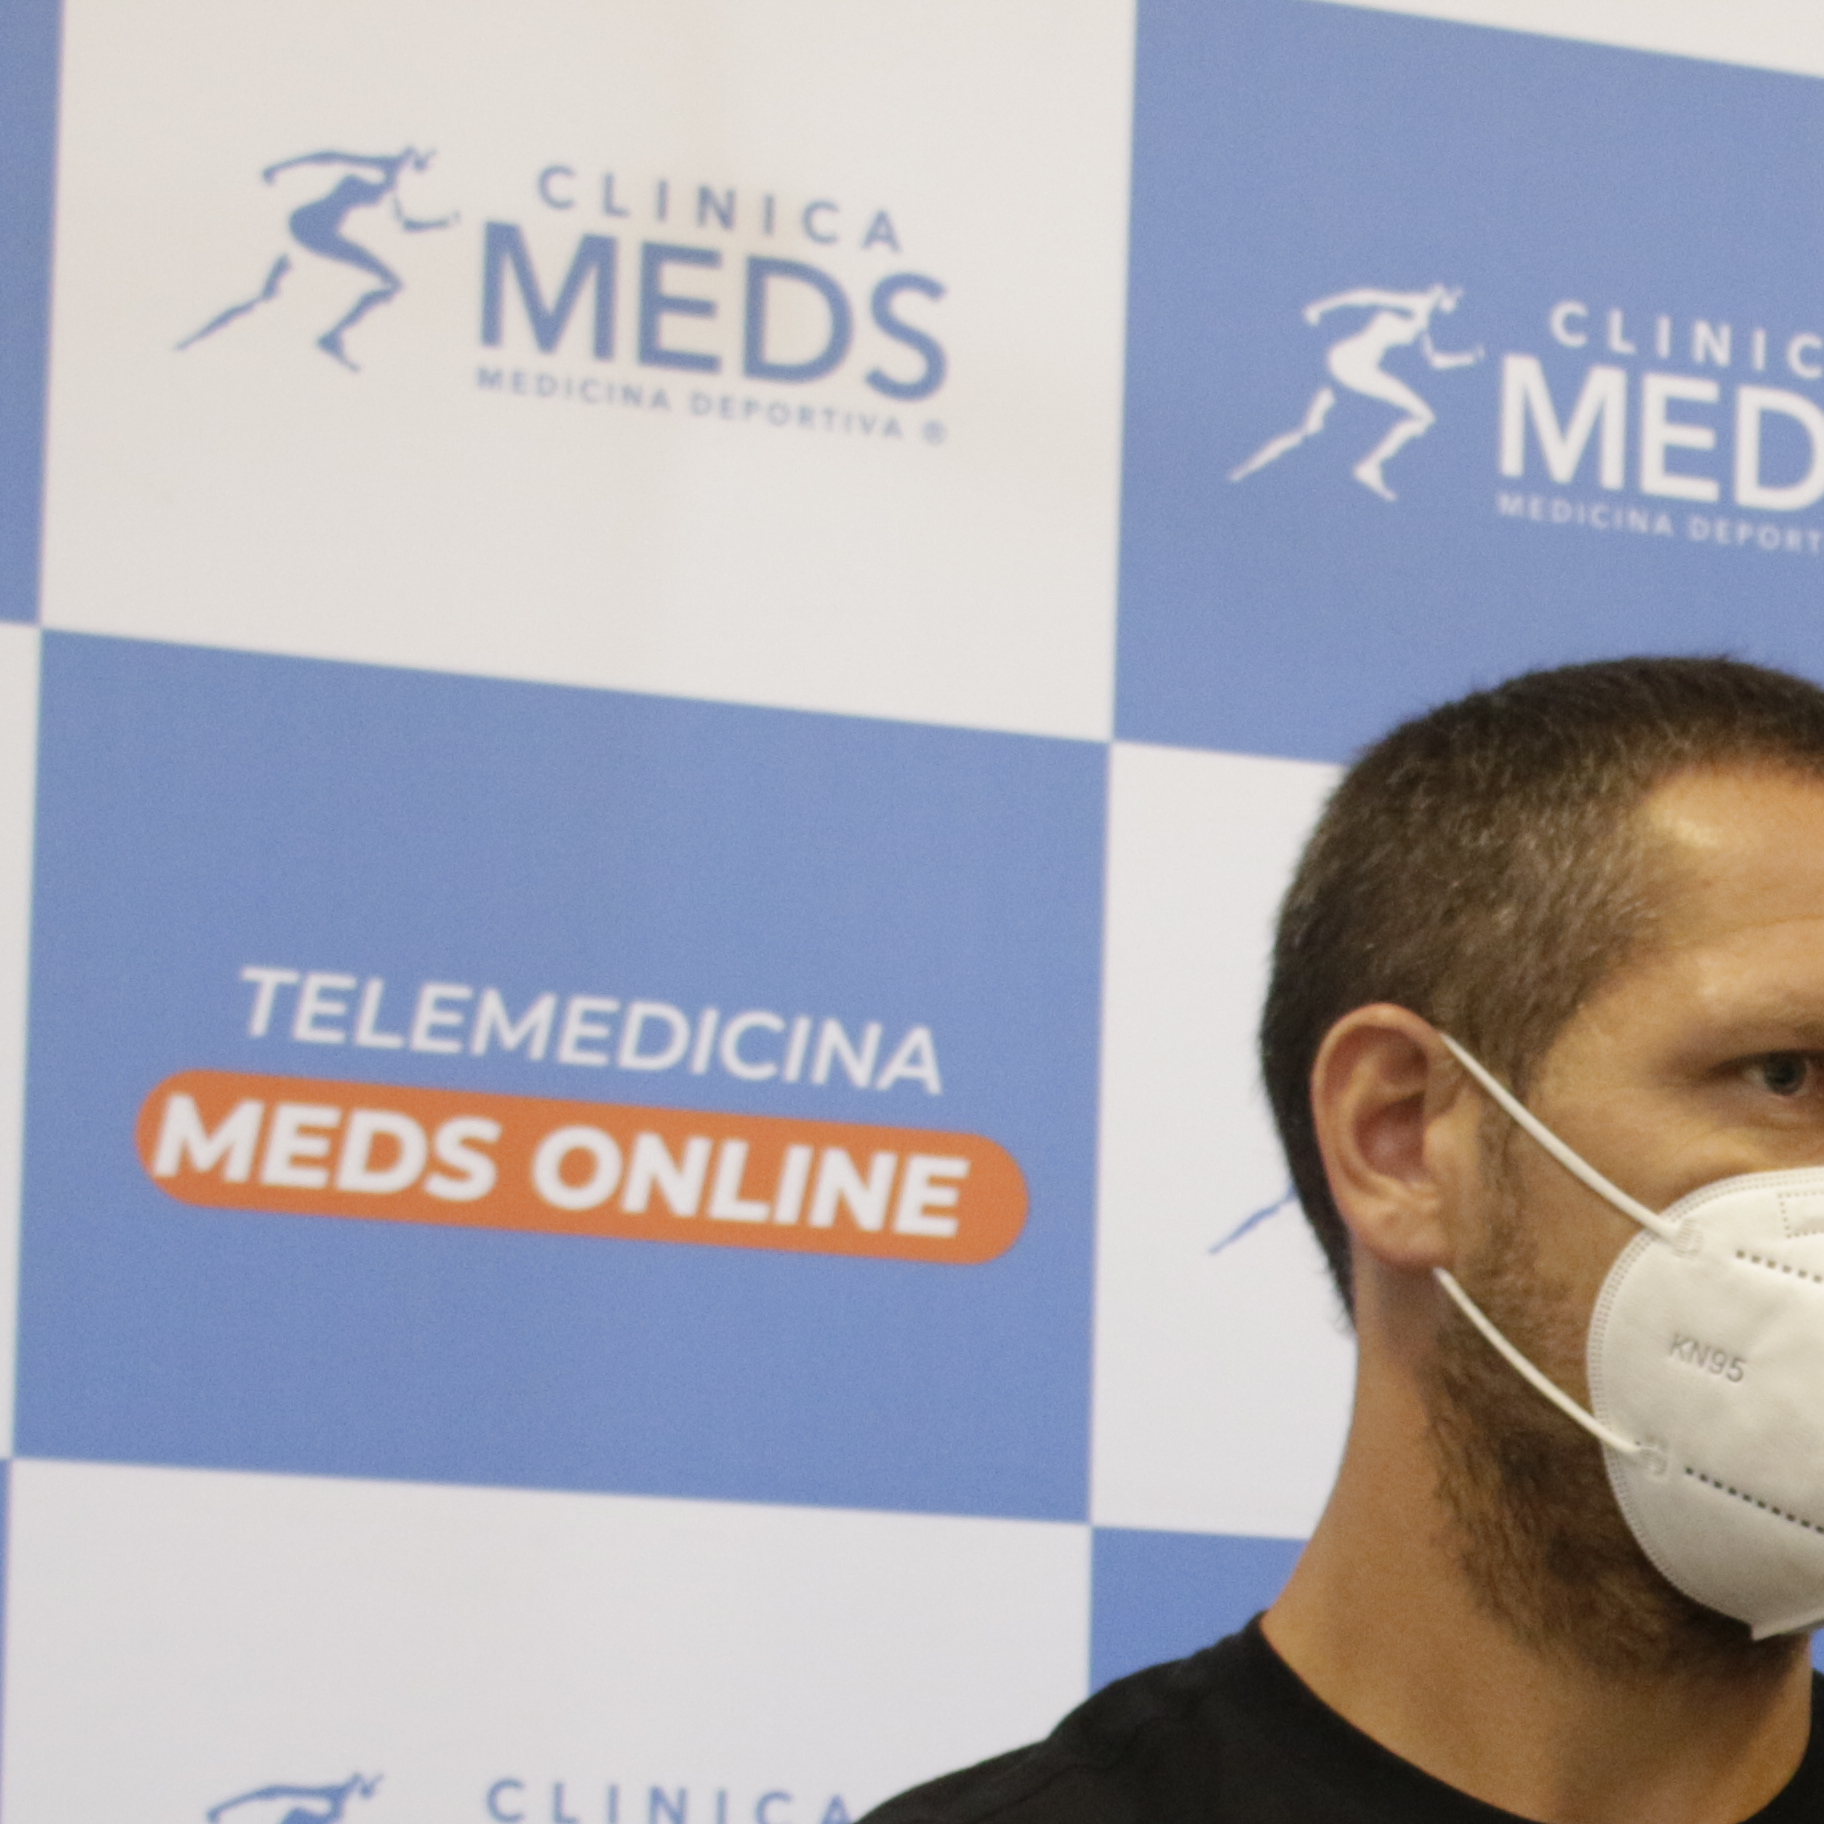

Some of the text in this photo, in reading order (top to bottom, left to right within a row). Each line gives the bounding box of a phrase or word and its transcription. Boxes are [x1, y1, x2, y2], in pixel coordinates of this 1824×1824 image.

[537, 164, 899, 251] CLINICA
[481, 221, 945, 400] MEDS
[477, 367, 901, 436] MEDICINA DEPORTIVA
[1498, 493, 1672, 533] MEDICINA
[241, 966, 942, 1095] TELEMEDICINA
[152, 1093, 968, 1236] MEDS ONLINE
[1669, 1332, 1746, 1383] KN95
